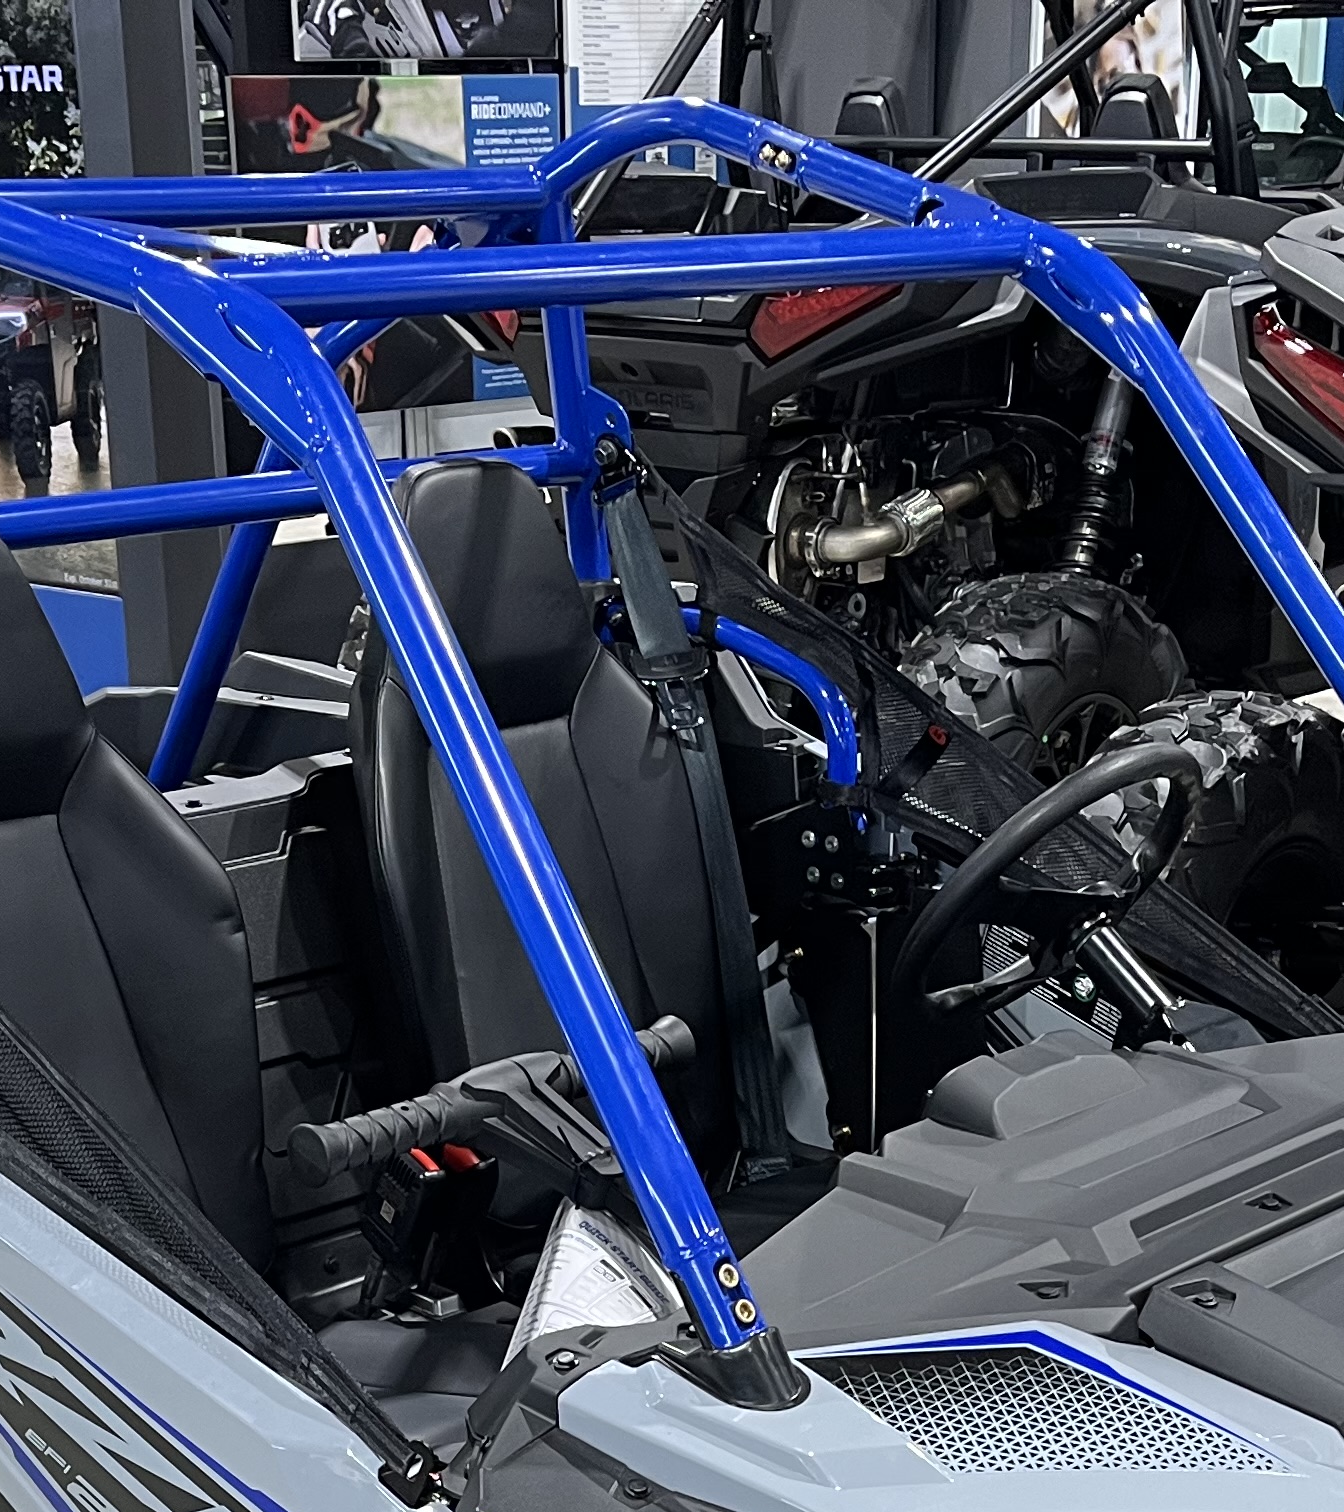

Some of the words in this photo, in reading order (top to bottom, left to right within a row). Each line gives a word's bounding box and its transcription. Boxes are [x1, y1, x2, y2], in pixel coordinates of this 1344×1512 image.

[578, 1220, 613, 1245] QUICK
[610, 1245, 641, 1274] START
[24, 1428, 71, 1474] EFI
